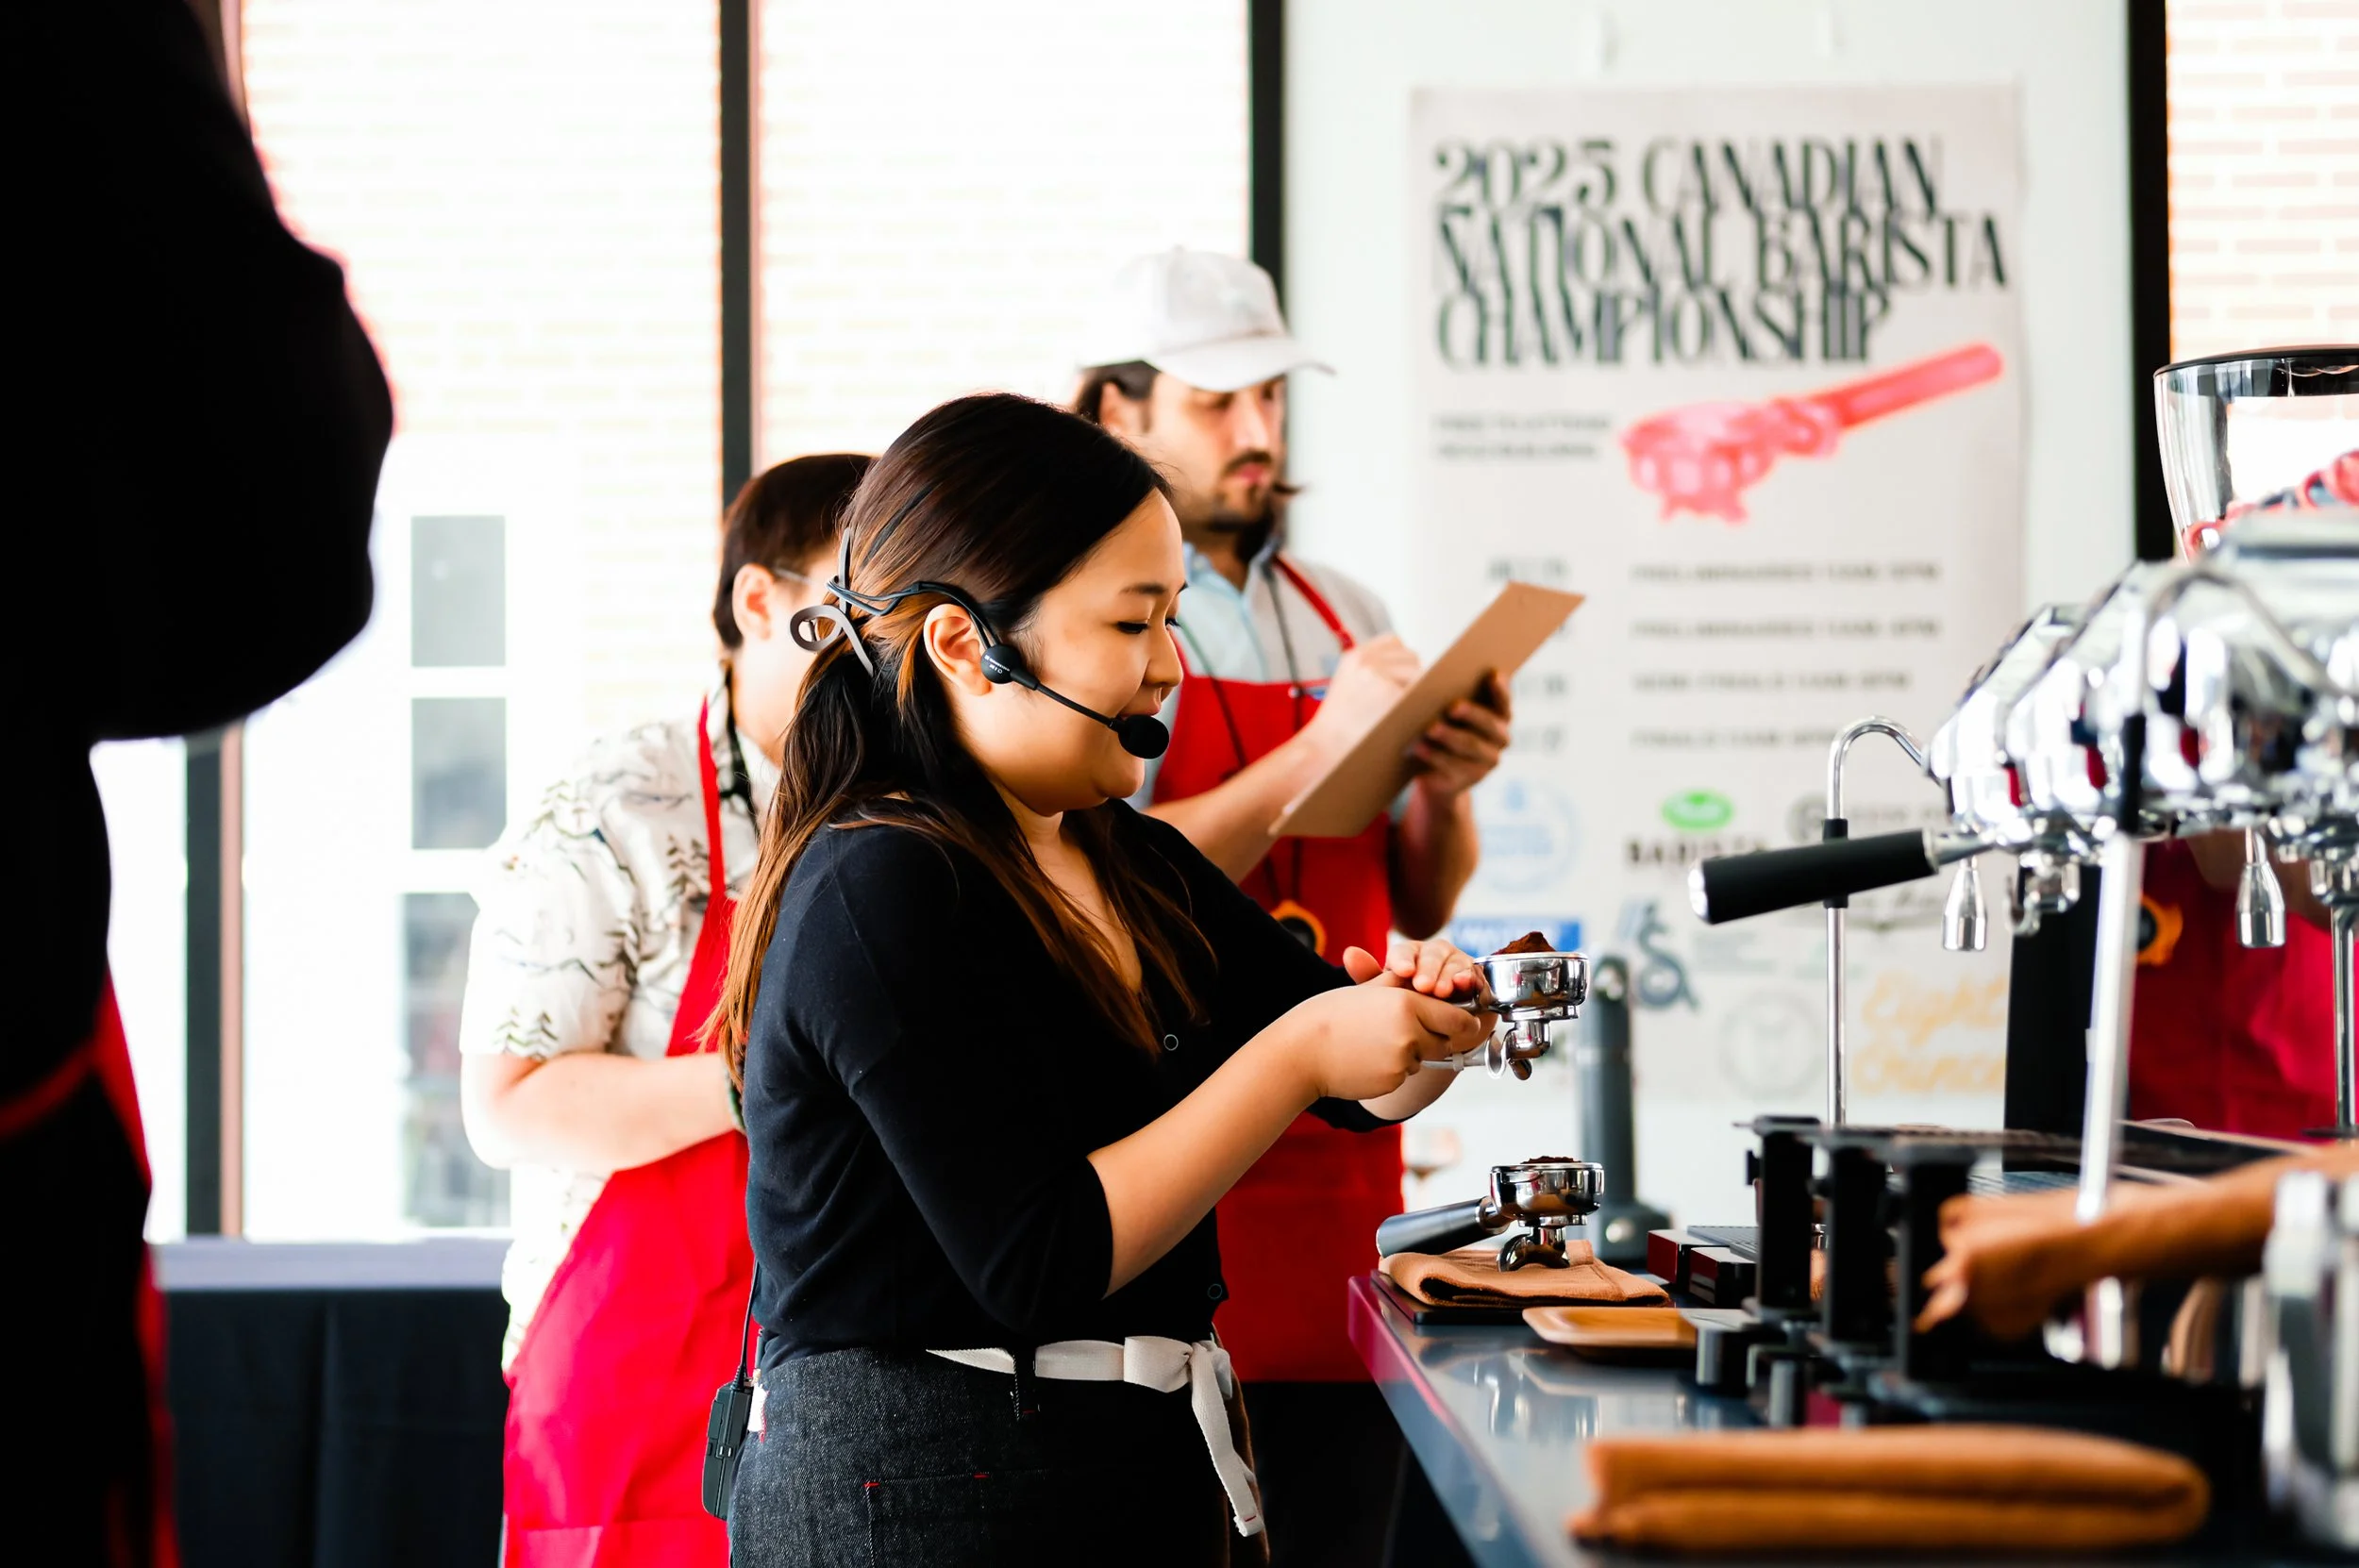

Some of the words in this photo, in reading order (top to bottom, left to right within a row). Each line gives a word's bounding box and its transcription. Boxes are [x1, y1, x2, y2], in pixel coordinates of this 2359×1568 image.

[1435, 138, 1615, 209] 2025
[1642, 138, 1941, 216] CANADIAN
[1434, 205, 1719, 291] NATIONAL
[1751, 208, 2008, 291] BARISTA
[1436, 285, 1890, 366] CHAMPIONSHIP
